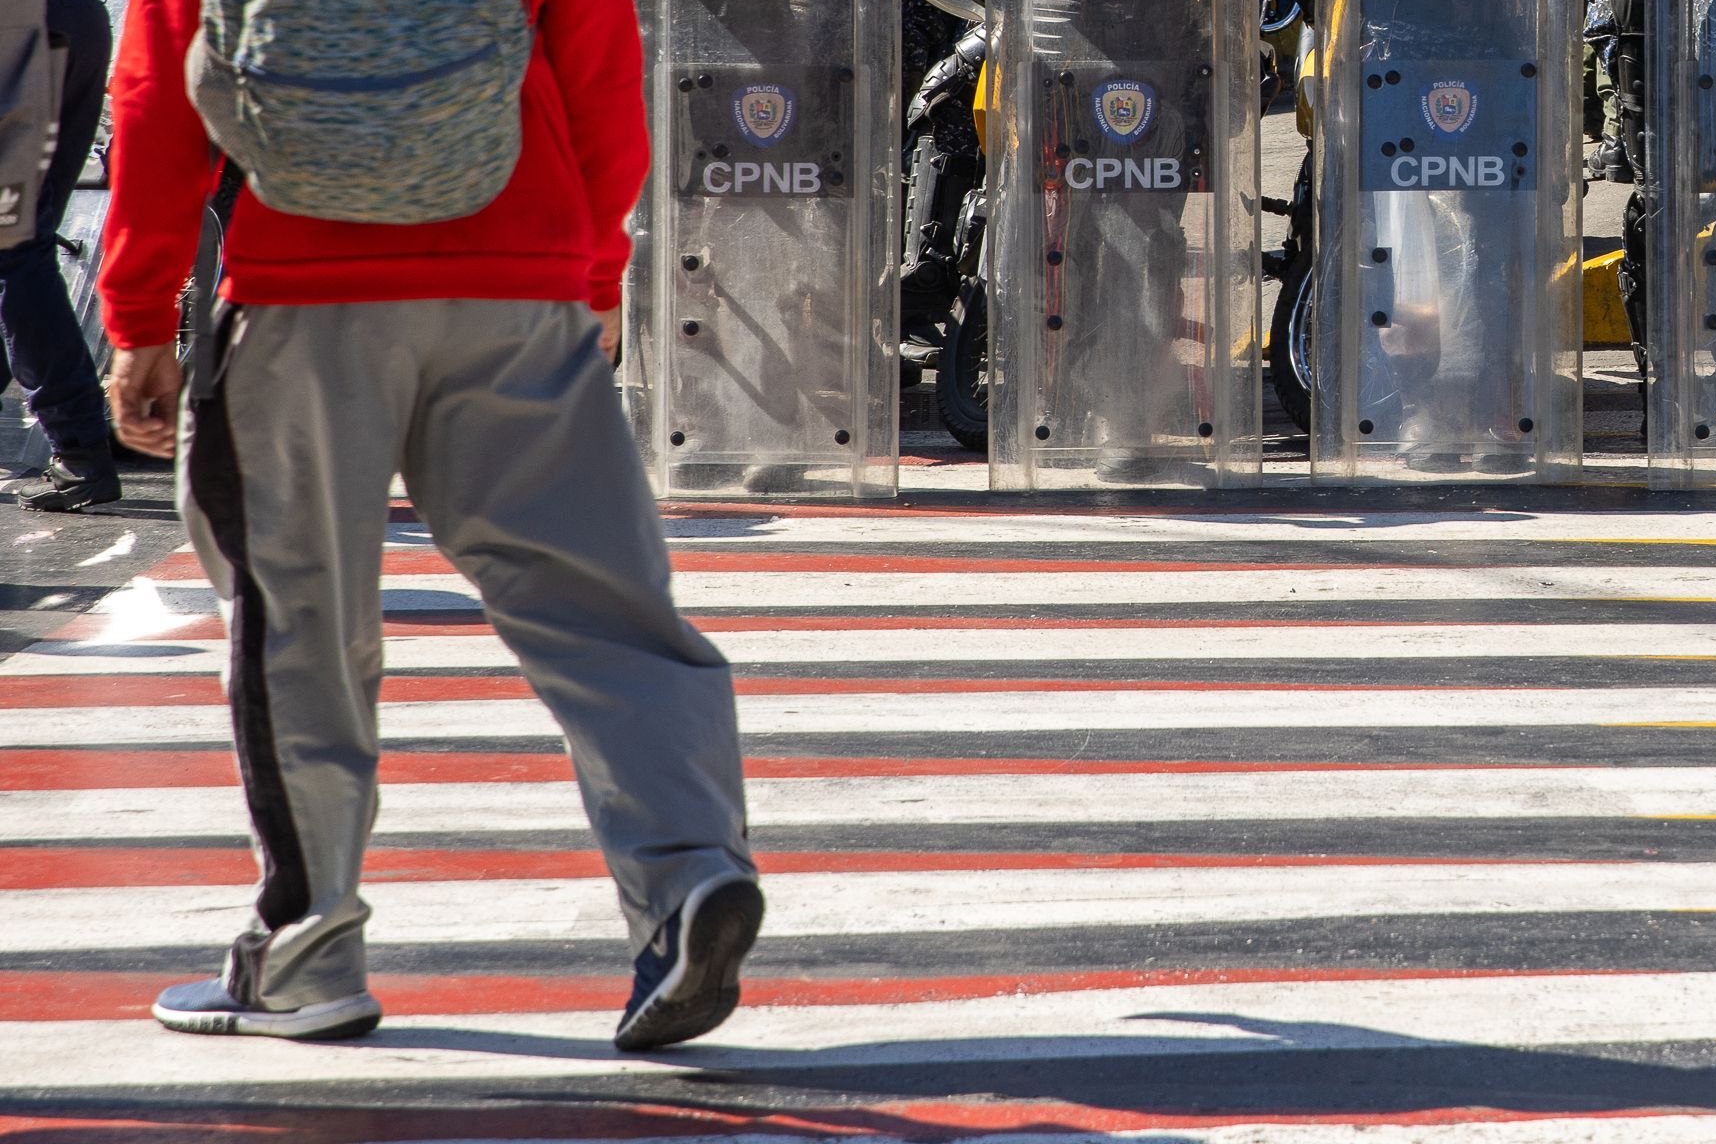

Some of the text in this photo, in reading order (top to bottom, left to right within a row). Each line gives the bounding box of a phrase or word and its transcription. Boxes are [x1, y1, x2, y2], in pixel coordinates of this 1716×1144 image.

[1107, 82, 1140, 91] POLICÍA
[1095, 97, 1109, 133] NACIONAL
[703, 161, 821, 194] CPNB
[1064, 157, 1182, 189] CPNB
[1390, 155, 1506, 187] CPNB
